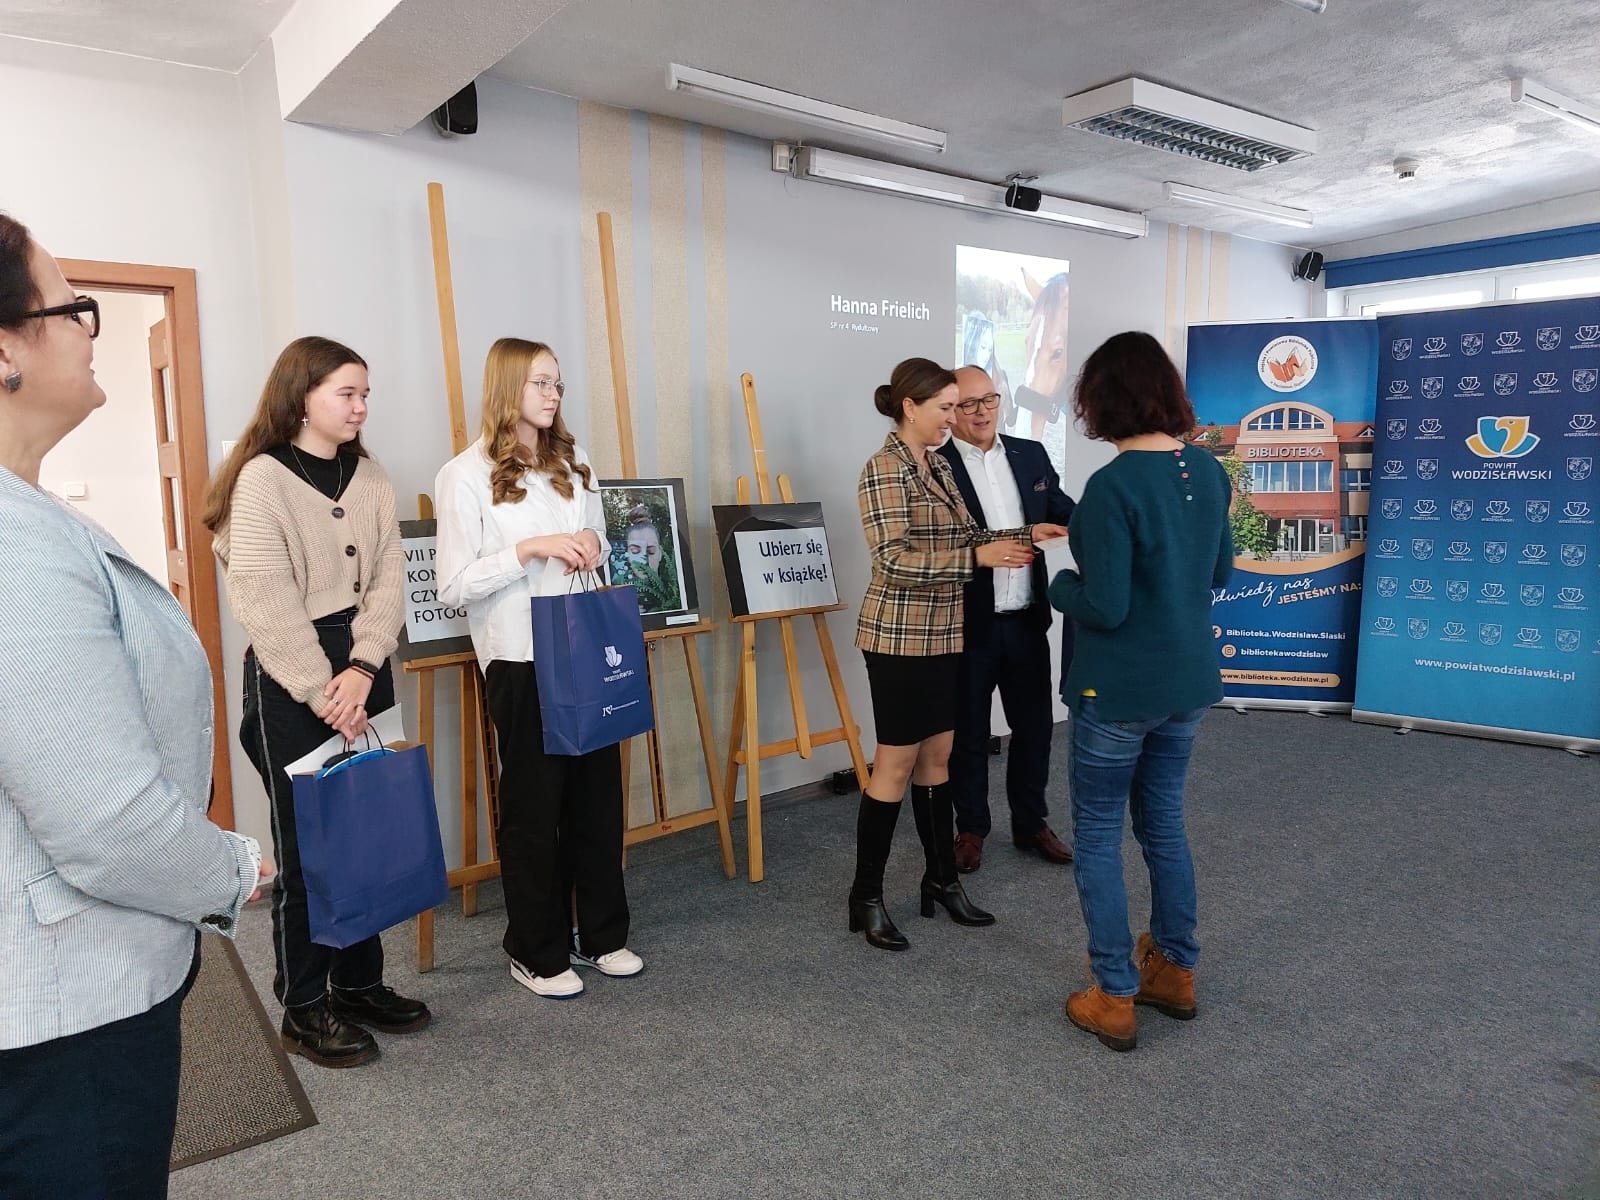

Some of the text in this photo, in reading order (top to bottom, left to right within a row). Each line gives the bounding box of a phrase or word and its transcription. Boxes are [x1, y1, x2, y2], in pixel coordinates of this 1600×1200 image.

[831, 294, 930, 321] Hanna Frielich
[1247, 446, 1325, 458] BIBLIOTEKA
[1483, 462, 1519, 470] POWIAT
[1452, 470, 1552, 480] WODZISŁAWSKI
[759, 539, 824, 557] Ubierz się
[404, 549, 425, 562] VII
[763, 563, 828, 584] w książkę!
[1283, 577, 1314, 591] nas
[411, 589, 438, 603] CZY
[1277, 582, 1362, 605] JESTEŚMY NA:
[414, 605, 468, 623] FOTOG
[1226, 629, 1347, 640] Biblioteka.Wodzislaw.Slaski
[1240, 648, 1329, 659] bibliotekawodzislaw
[1414, 658, 1576, 682] www.powiatwodzislawski.pl
